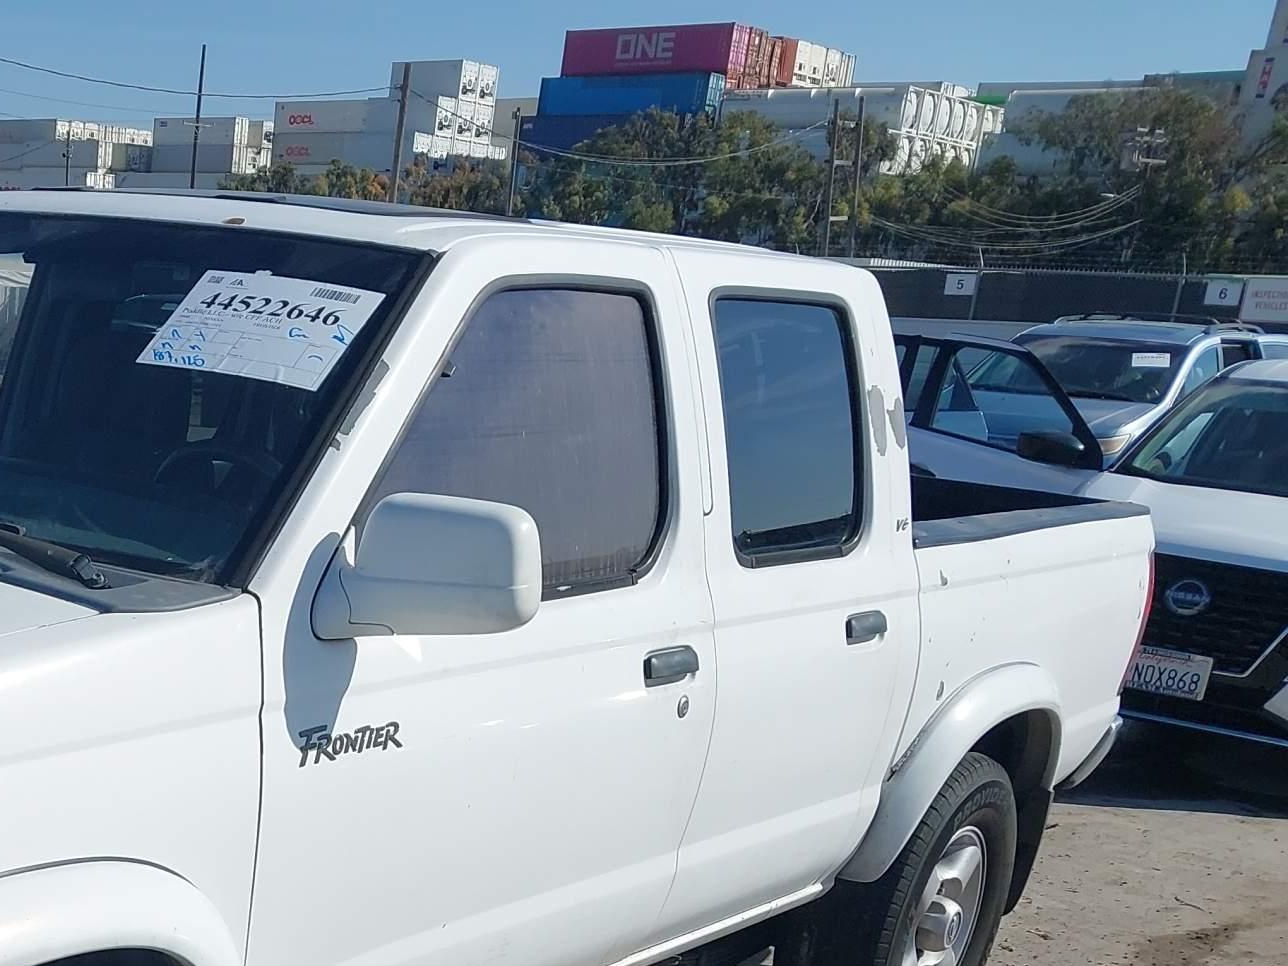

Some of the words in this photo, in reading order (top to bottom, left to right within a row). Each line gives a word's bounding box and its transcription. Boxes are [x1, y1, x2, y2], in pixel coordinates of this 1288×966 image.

[616, 32, 676, 59] ONE
[289, 115, 314, 125] OOCL
[957, 280, 965, 289] 5
[1219, 288, 1228, 299] 6
[200, 292, 347, 326] 44522646
[299, 721, 403, 768] FRONTIER
